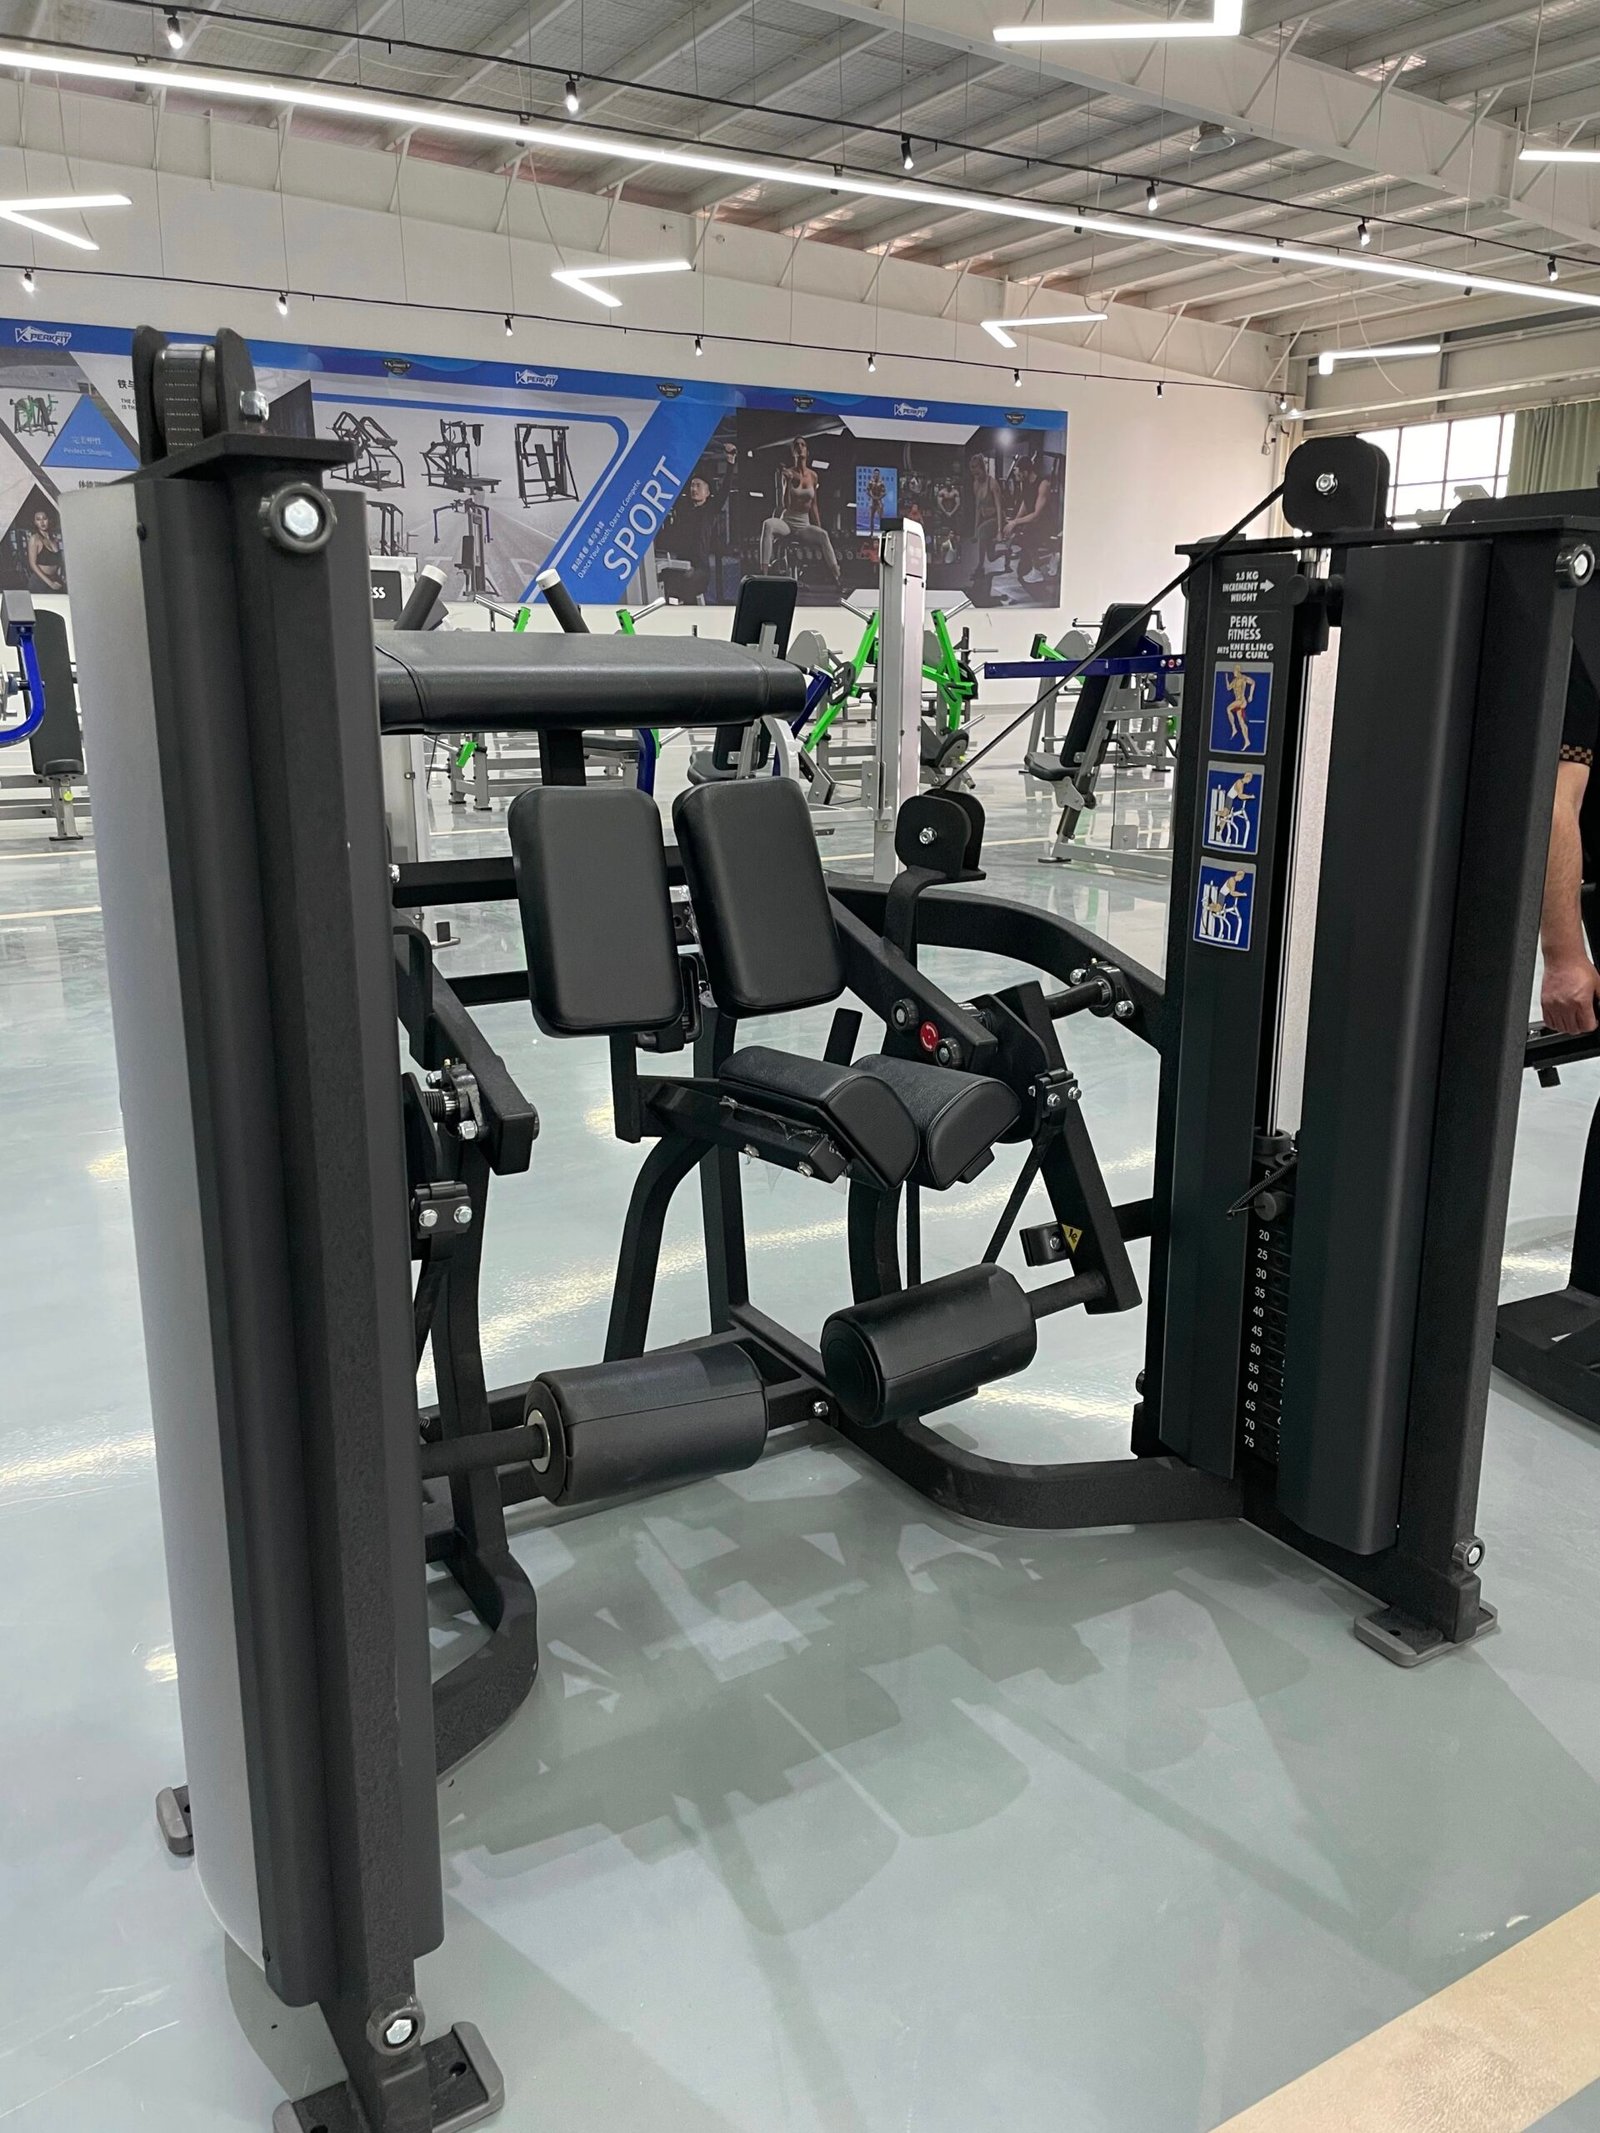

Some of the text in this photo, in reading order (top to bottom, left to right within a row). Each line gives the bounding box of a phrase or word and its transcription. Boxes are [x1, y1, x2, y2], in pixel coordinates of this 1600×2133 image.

[603, 455, 681, 580] SPORT
[577, 559, 593, 579] Dance
[590, 544, 602, 560] Your
[609, 511, 622, 528] Dare
[622, 479, 642, 507] Compete
[1246, 571, 1259, 580] KG
[1222, 582, 1259, 592] INCREMENT
[1230, 592, 1258, 602] WEIGHT
[1230, 615, 1258, 628] PEAK
[1227, 628, 1261, 640] FITNESS
[1229, 643, 1274, 651] KNEELING
[1229, 651, 1269, 659] LEG CURL
[1259, 1229, 1270, 1241] 20
[1257, 1248, 1268, 1260] 25
[1255, 1267, 1267, 1279] 30
[1254, 1286, 1265, 1298] 35
[1253, 1306, 1264, 1317] 40
[1251, 1325, 1262, 1337] 45
[1250, 1343, 1261, 1355] 50
[1248, 1362, 1259, 1375] 55
[1247, 1381, 1258, 1392] 60
[1245, 1399, 1256, 1411] 65
[1244, 1417, 1255, 1430] 70
[1244, 1434, 1255, 1448] 75
